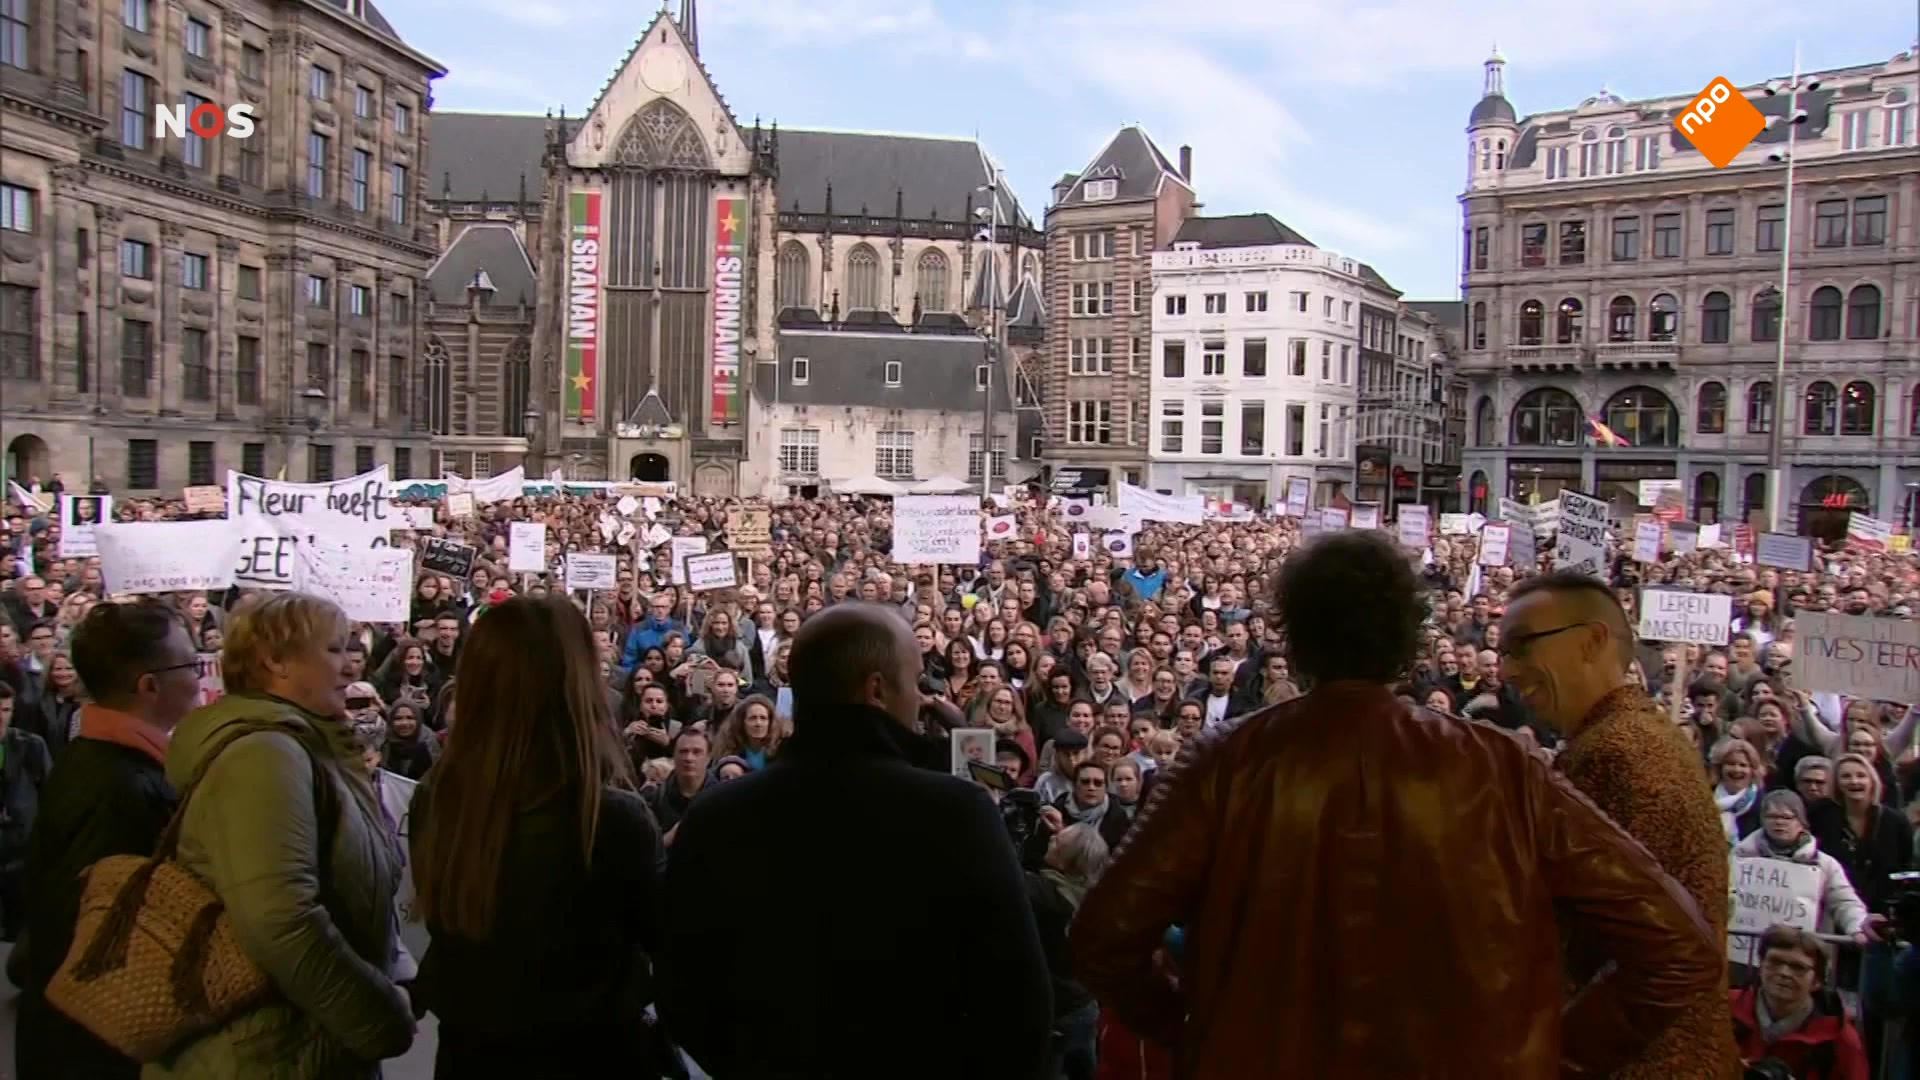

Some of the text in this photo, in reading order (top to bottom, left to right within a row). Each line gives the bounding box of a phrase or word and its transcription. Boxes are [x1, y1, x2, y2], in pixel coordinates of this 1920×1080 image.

[569, 238, 599, 338] SRANAN
[714, 257, 742, 377] SURINAME
[237, 475, 316, 515] Fleur
[326, 480, 388, 521] heeft
[1659, 593, 1711, 615] LEREN
[1739, 864, 1790, 887] HAAL
[1735, 889, 1808, 922] NDERWIJS
